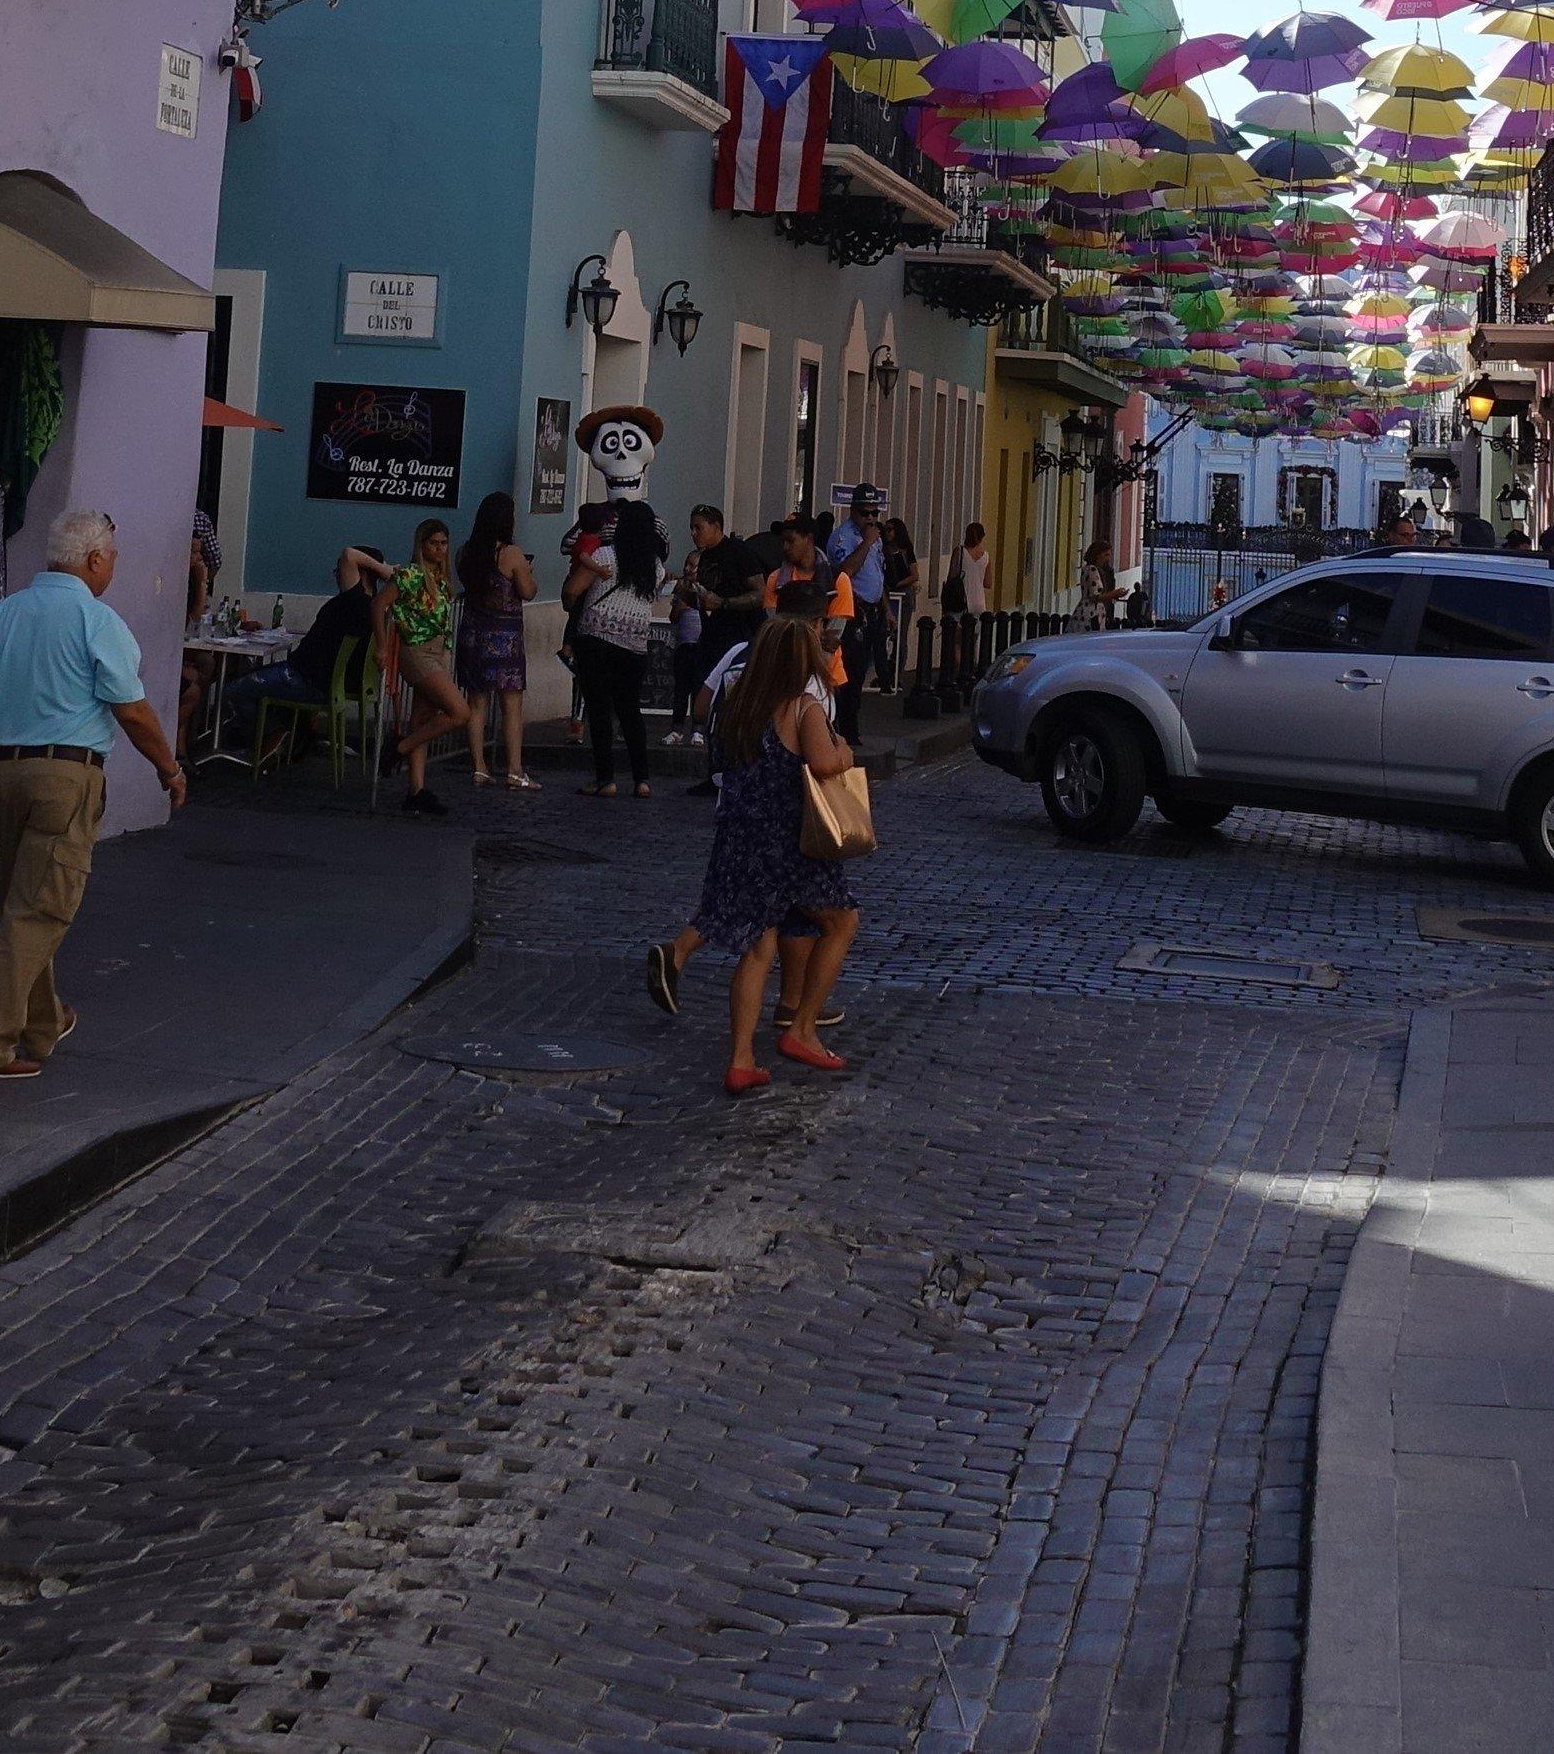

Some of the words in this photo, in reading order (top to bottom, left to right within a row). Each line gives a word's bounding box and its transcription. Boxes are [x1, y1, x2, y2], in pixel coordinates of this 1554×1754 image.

[169, 54, 191, 80] CALLE
[369, 280, 415, 296] CALLE
[382, 300, 401, 311] DEL
[367, 314, 413, 330] CRISTO
[348, 456, 383, 473] Rest.
[387, 458, 404, 478] La
[407, 459, 454, 478] Danza
[347, 476, 446, 498] 787-723-1642
